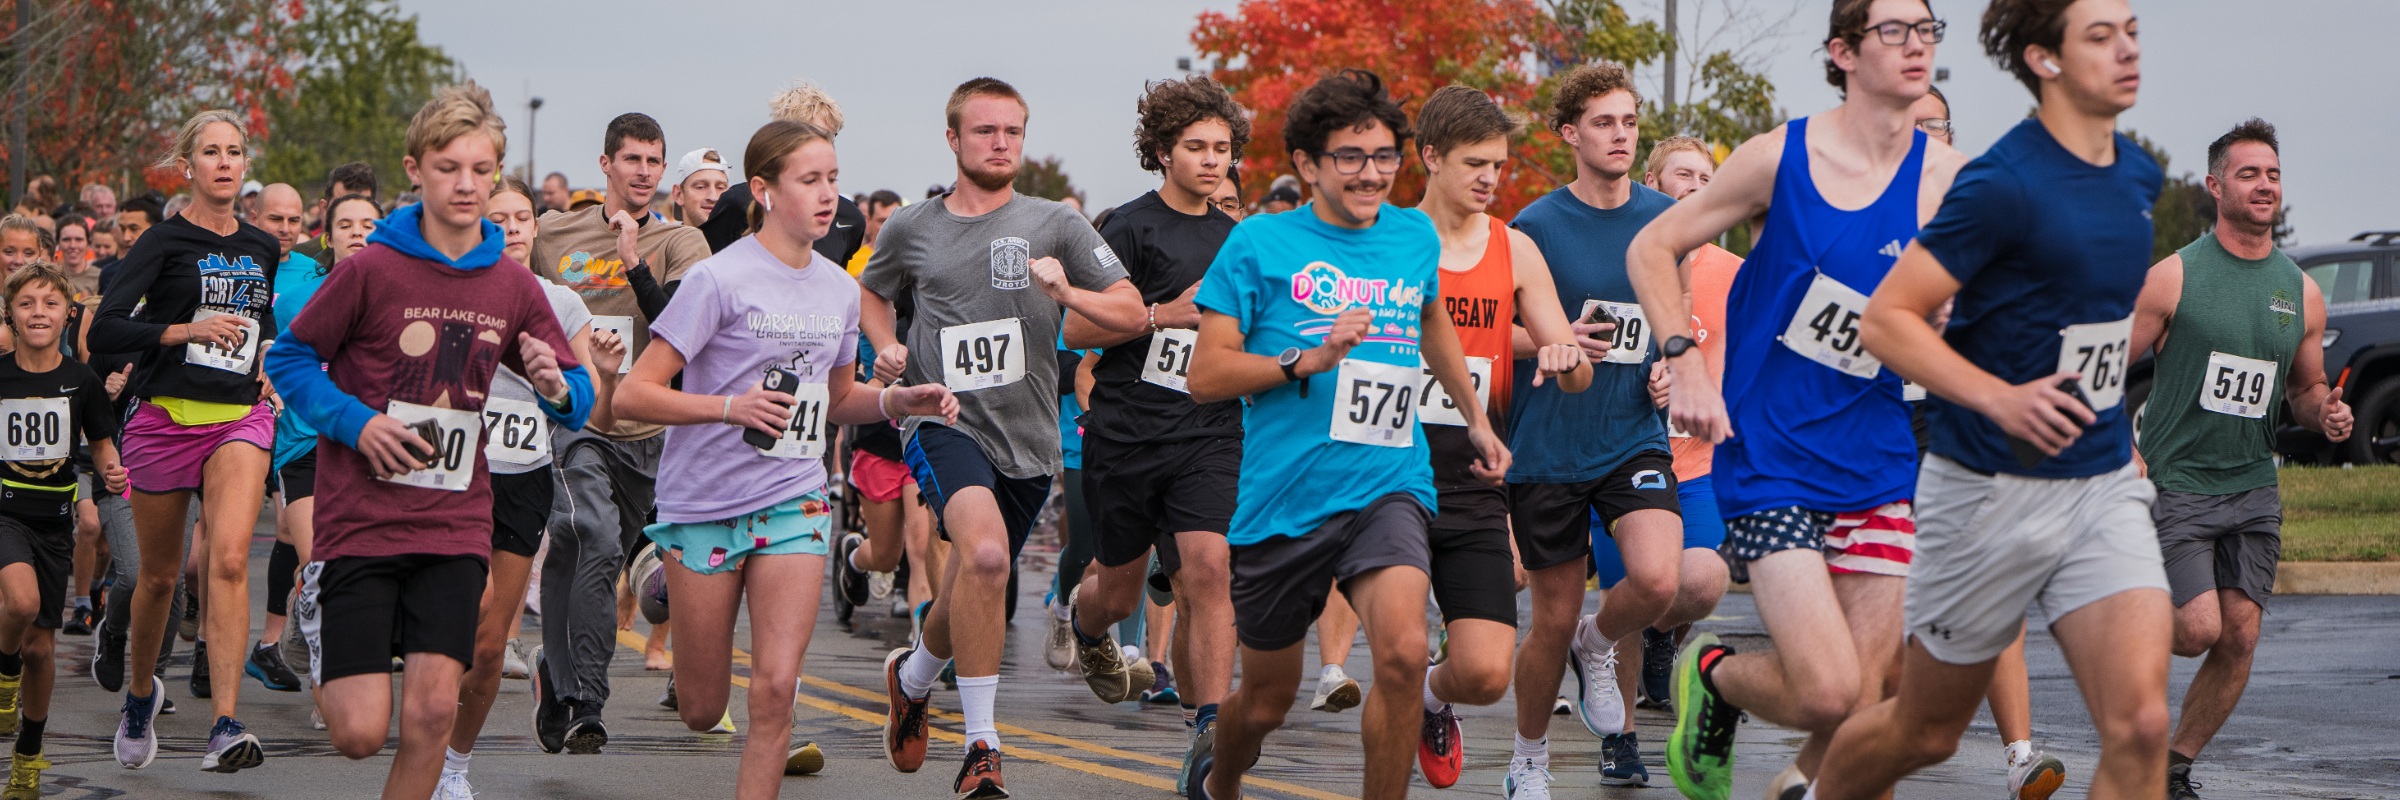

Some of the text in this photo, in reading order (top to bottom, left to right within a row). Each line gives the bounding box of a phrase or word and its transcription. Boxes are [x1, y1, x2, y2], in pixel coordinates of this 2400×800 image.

[1007, 238, 1026, 246] ARMY
[201, 275, 234, 304] FORT
[403, 307, 507, 330] BEAR LAKE CAMP
[747, 312, 842, 332] WARSAW TIGER
[1446, 297, 1498, 329] RSAW
[1611, 316, 1642, 351] 09
[955, 333, 1011, 376] 497
[1157, 336, 1192, 378] 51
[2077, 339, 2127, 391] 763
[2213, 366, 2265, 405] 519
[1349, 379, 1412, 430] 579
[7, 411, 60, 446] 680
[486, 410, 538, 451] 762
